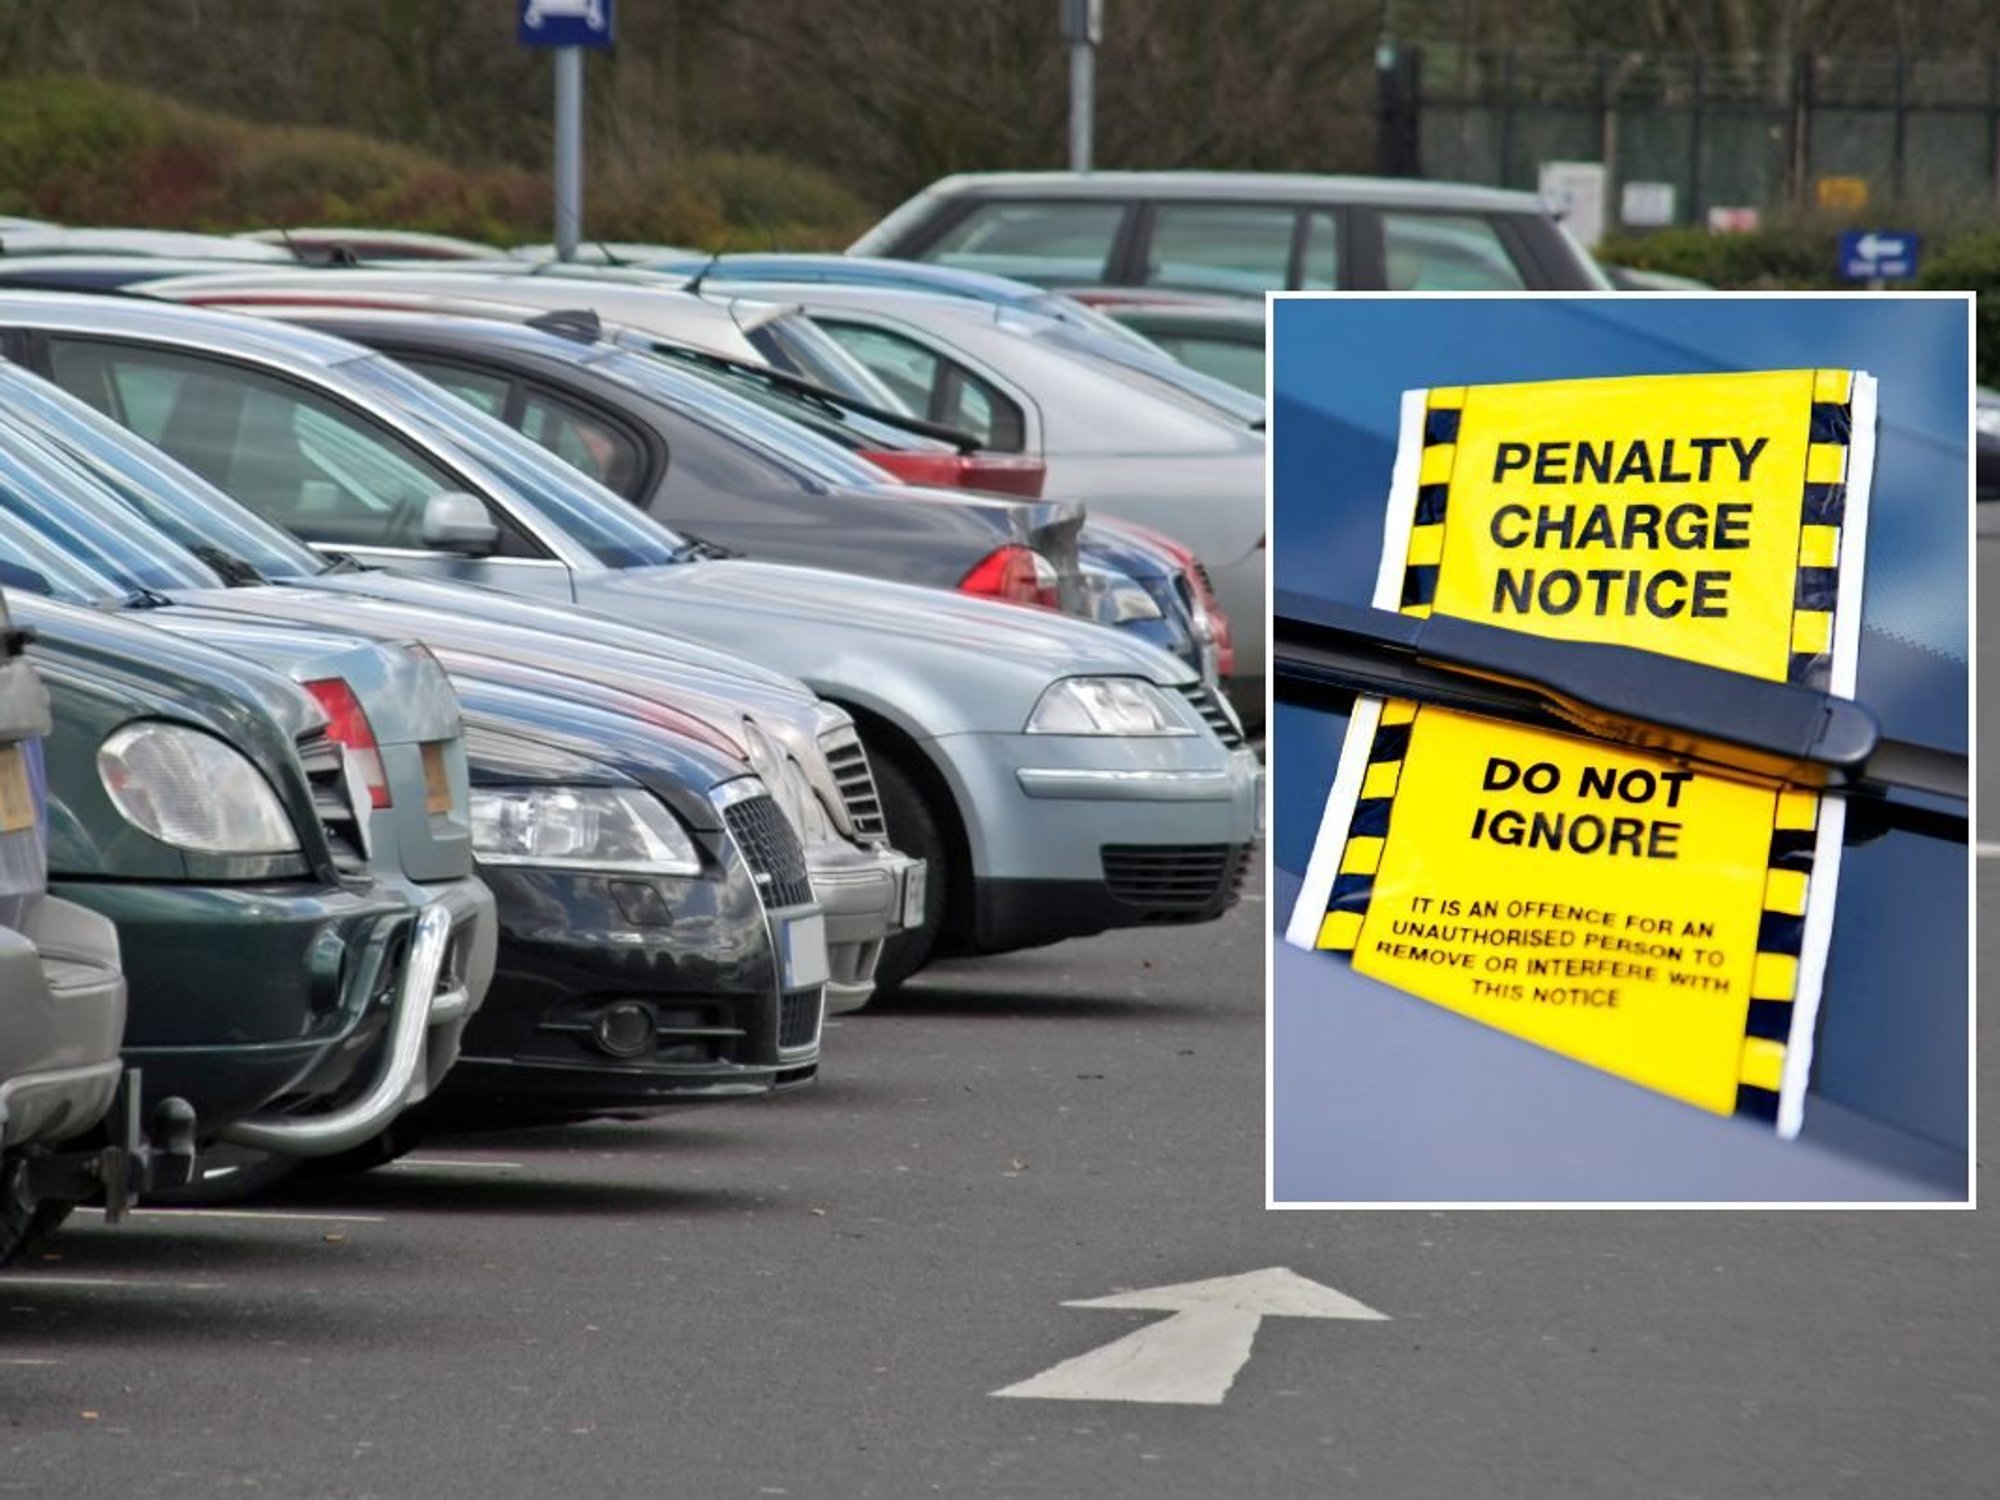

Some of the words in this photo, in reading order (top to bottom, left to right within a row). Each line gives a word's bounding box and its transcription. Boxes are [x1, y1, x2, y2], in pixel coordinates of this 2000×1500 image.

[1491, 437, 1769, 484] PENALTY
[1490, 502, 1753, 550] CHARGE
[1492, 568, 1731, 618] NOTICE
[1482, 757, 1560, 794] DO
[1578, 767, 1693, 808] NOT
[1471, 808, 1682, 860] IGNORE
[1411, 897, 1433, 913] IT
[1440, 899, 1460, 917] IS
[1469, 900, 1499, 918] AN
[1507, 900, 1616, 928] OFFENCE
[1625, 914, 1674, 935] FOR
[1682, 922, 1714, 938] AN
[1376, 940, 1475, 970] REMOVE
[1485, 955, 1518, 972] OR
[1527, 958, 1657, 982] INTERFERE
[1669, 971, 1730, 994] WITH
[1392, 920, 1575, 947] UNAUTHORISED
[1585, 933, 1682, 961] PERSON
[1694, 949, 1725, 968] TO
[1472, 979, 1523, 1001] THIS
[1533, 985, 1621, 1008] NOTICE
